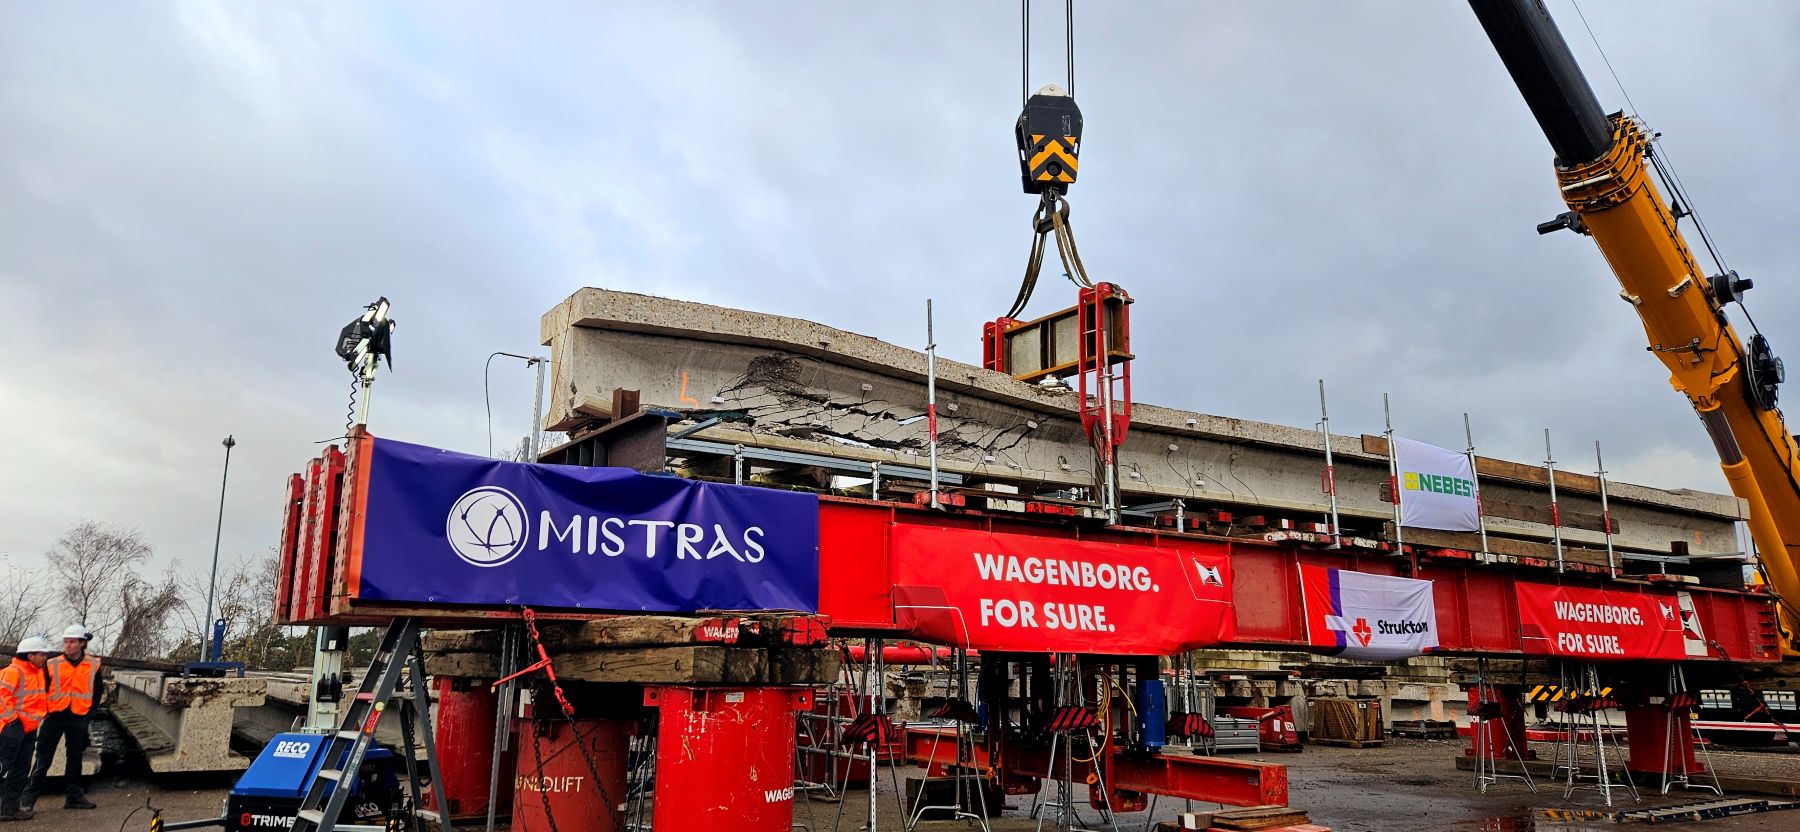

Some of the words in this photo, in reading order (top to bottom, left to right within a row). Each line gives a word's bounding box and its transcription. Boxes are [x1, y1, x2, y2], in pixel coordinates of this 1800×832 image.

[537, 510, 766, 563] MISTRAS
[973, 552, 1160, 592] WAGENBORG.
[980, 598, 1038, 628] FOR
[1043, 602, 1116, 633] SURE.
[1553, 600, 1644, 626] WAGENBORG.
[1377, 619, 1429, 635] Strukton
[1558, 632, 1586, 653] FOR
[1586, 634, 1625, 655] SURE.
[275, 740, 311, 754] RECO
